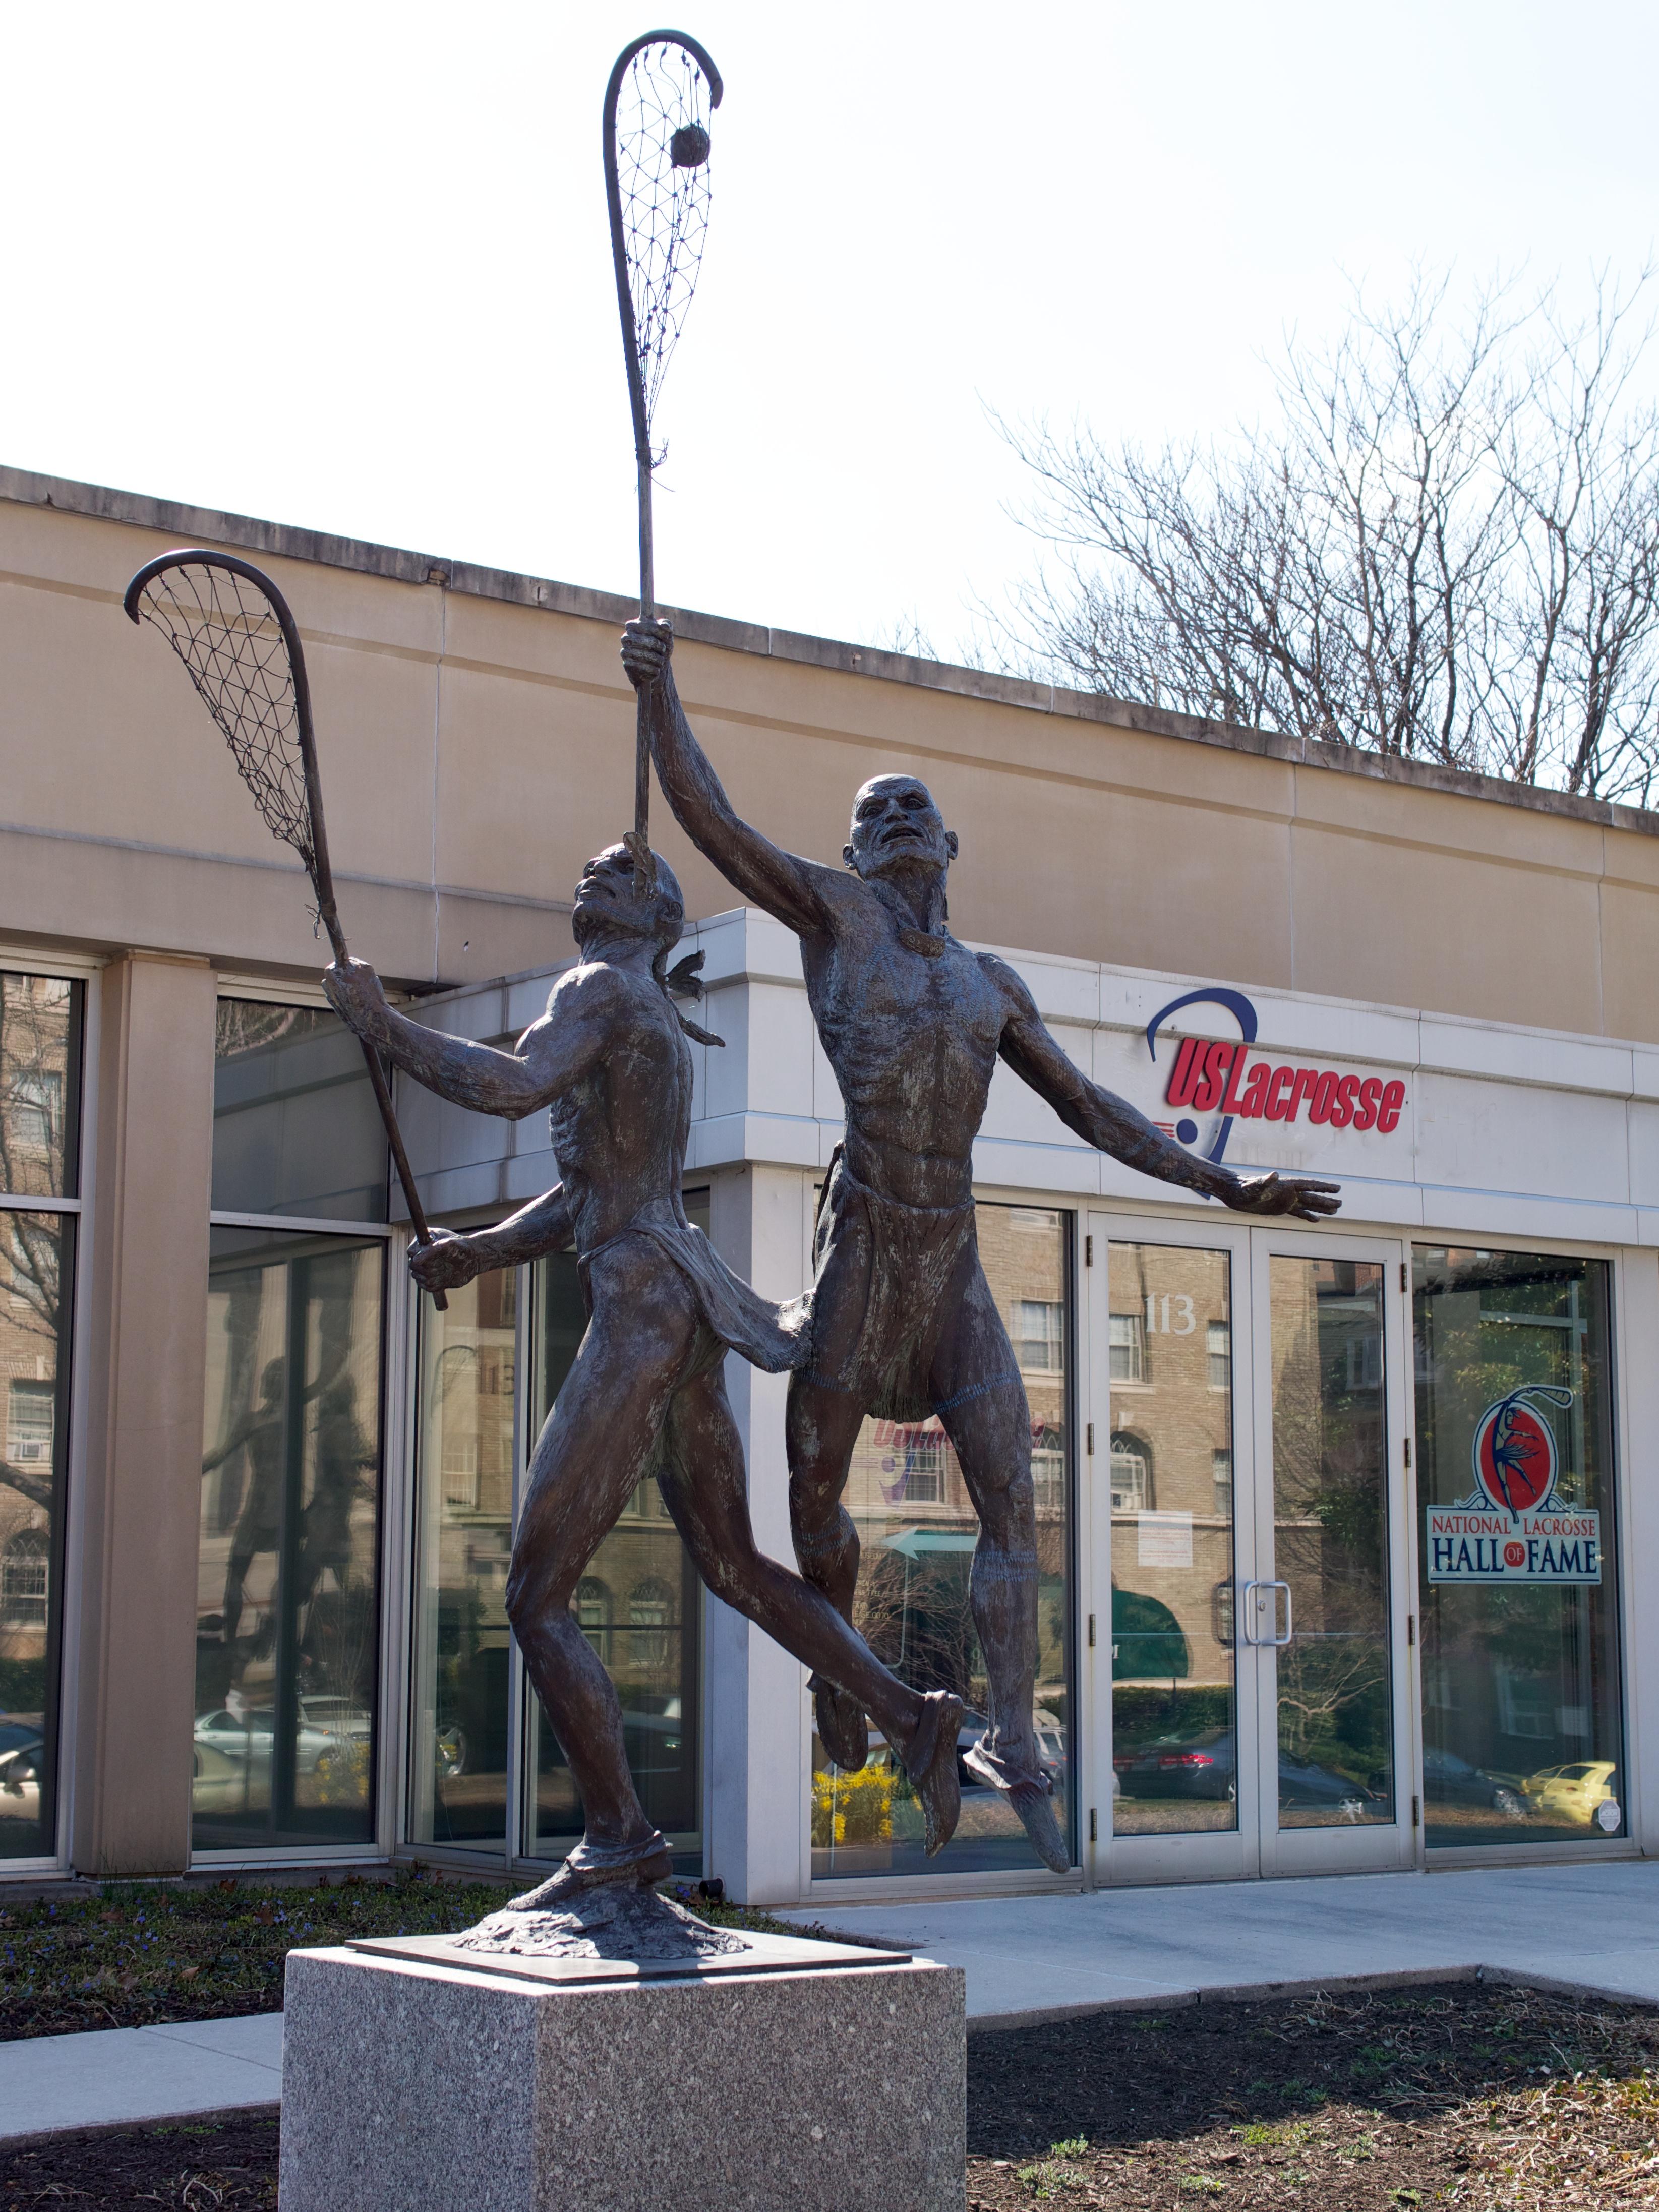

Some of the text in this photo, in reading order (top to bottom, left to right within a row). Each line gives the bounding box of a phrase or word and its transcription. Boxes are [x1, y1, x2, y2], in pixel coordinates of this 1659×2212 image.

[1144, 1291, 1196, 1335] 113
[1432, 1516, 1596, 1536] NATIONAL LACROSSE
[1432, 1537, 1597, 1574] HALL OF FAME
